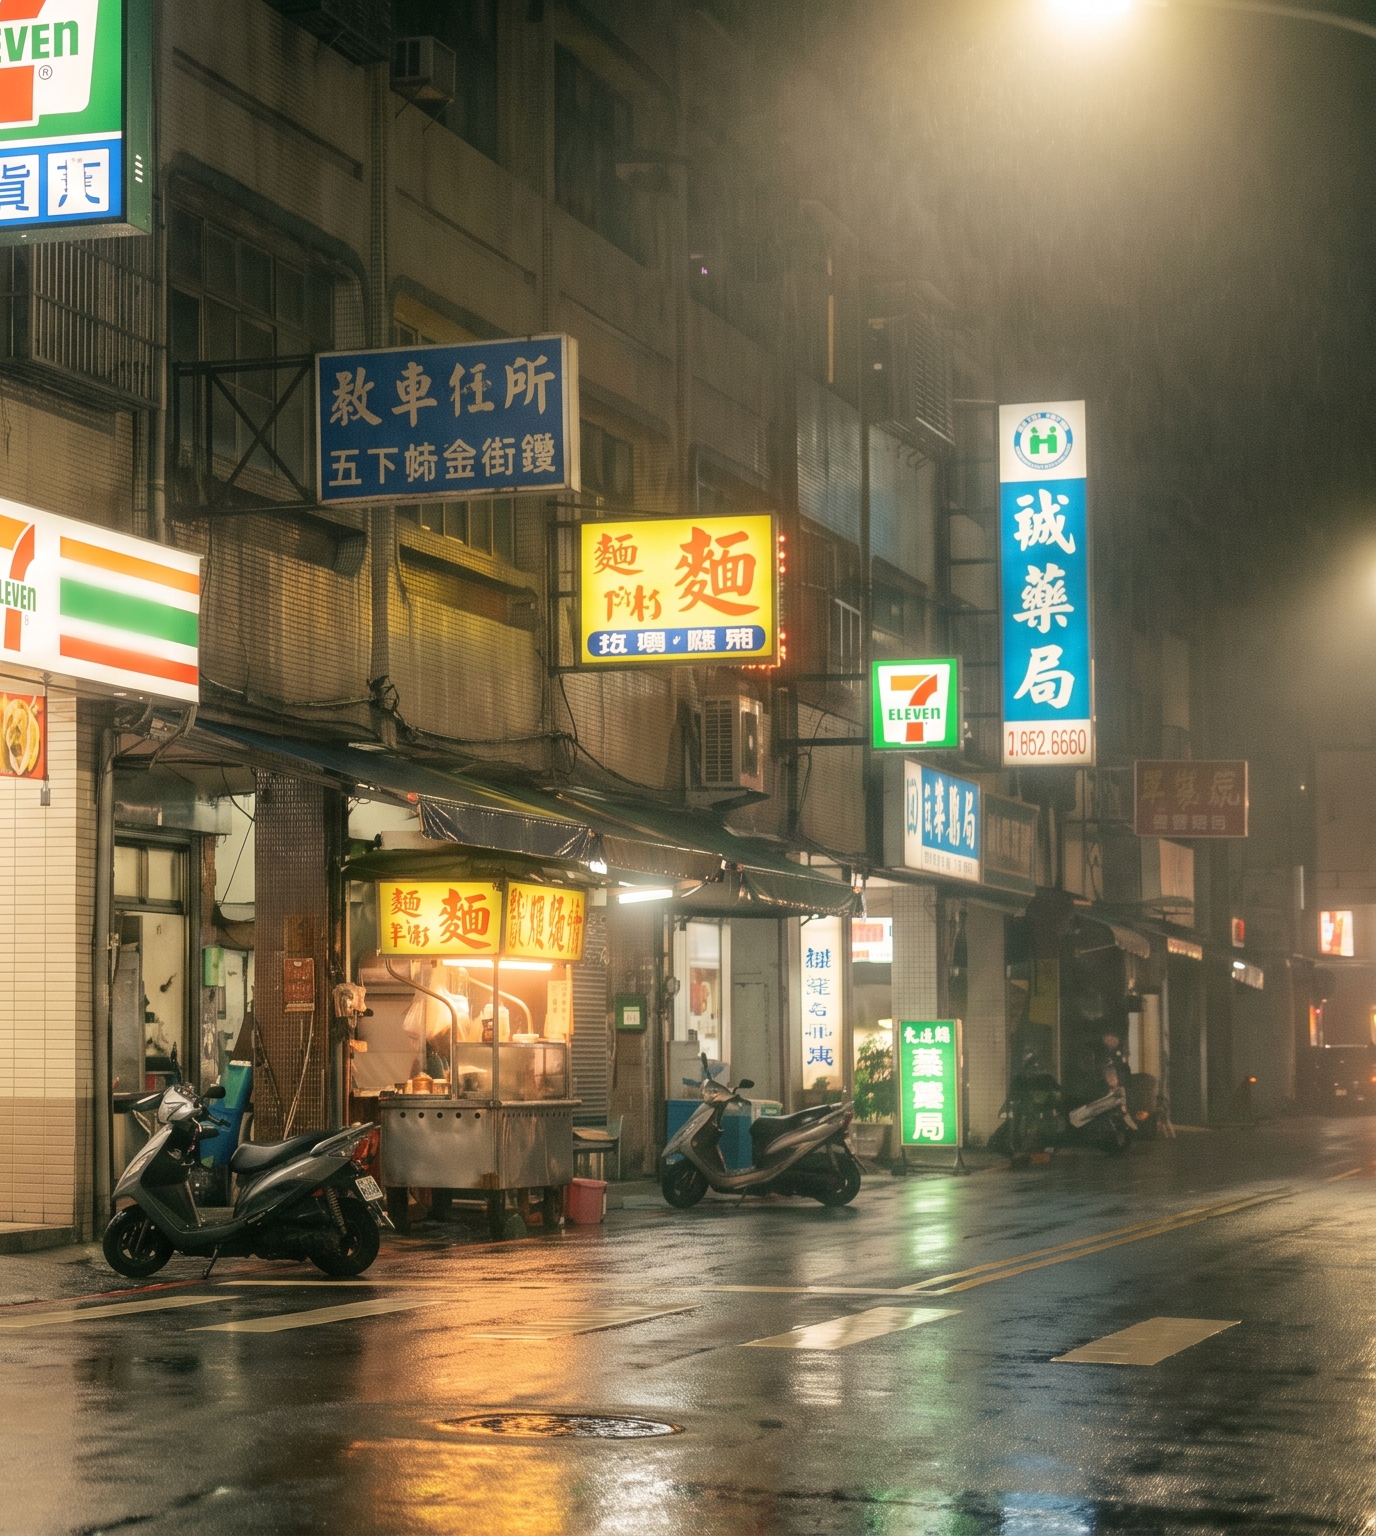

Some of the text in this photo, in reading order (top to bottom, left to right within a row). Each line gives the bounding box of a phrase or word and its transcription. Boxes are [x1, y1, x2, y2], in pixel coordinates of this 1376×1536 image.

[674, 526, 760, 616] 麵
[1013, 489, 1076, 709] 誠藥局
[890, 674, 937, 742] 7
[438, 888, 491, 950] 麵
